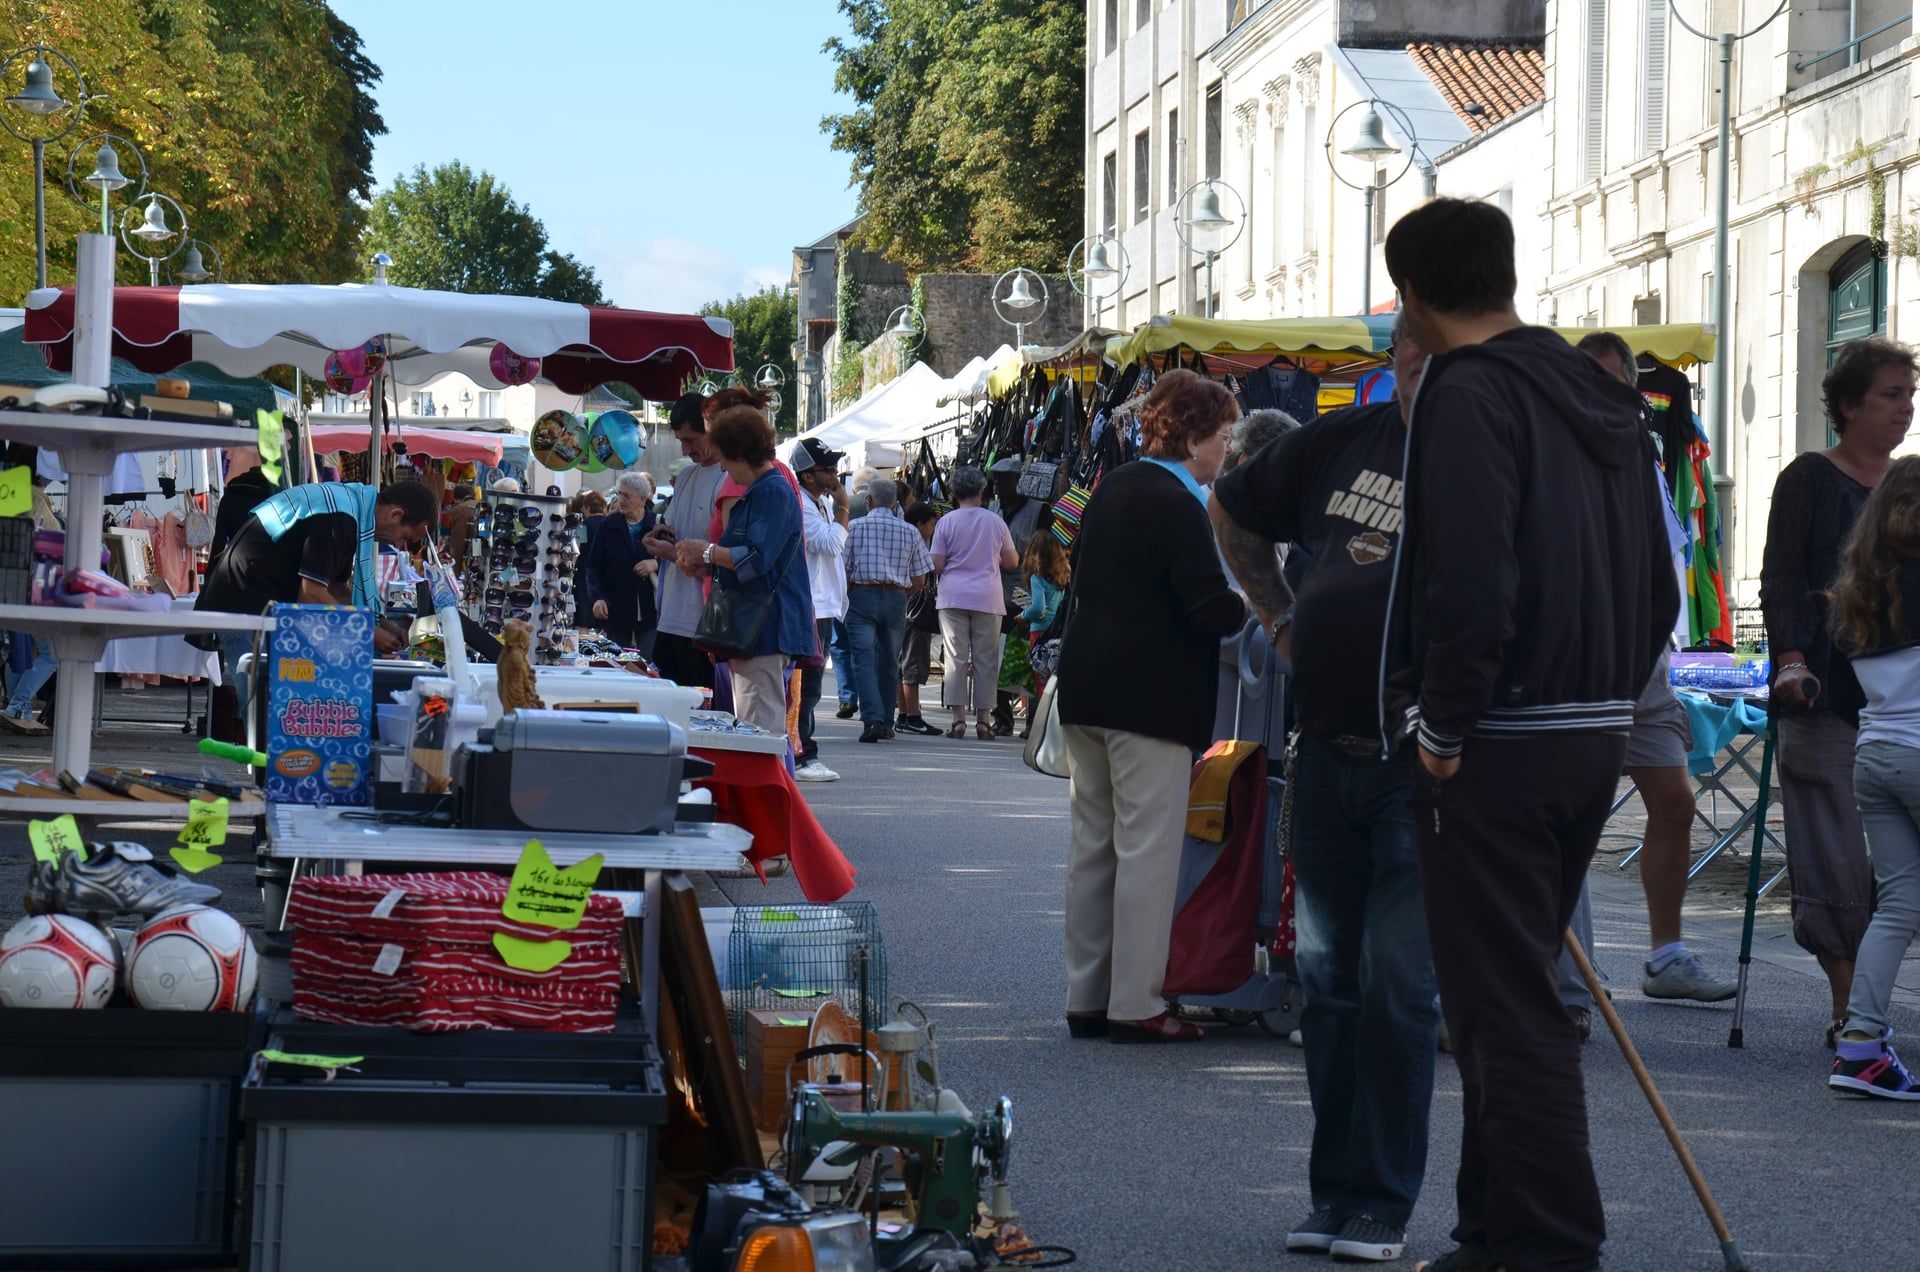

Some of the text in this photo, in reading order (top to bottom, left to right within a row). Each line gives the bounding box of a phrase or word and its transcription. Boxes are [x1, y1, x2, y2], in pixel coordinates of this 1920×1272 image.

[1325, 490, 1402, 534] DAVID
[286, 699, 359, 720] Bubble
[281, 716, 362, 737] Bubbles
